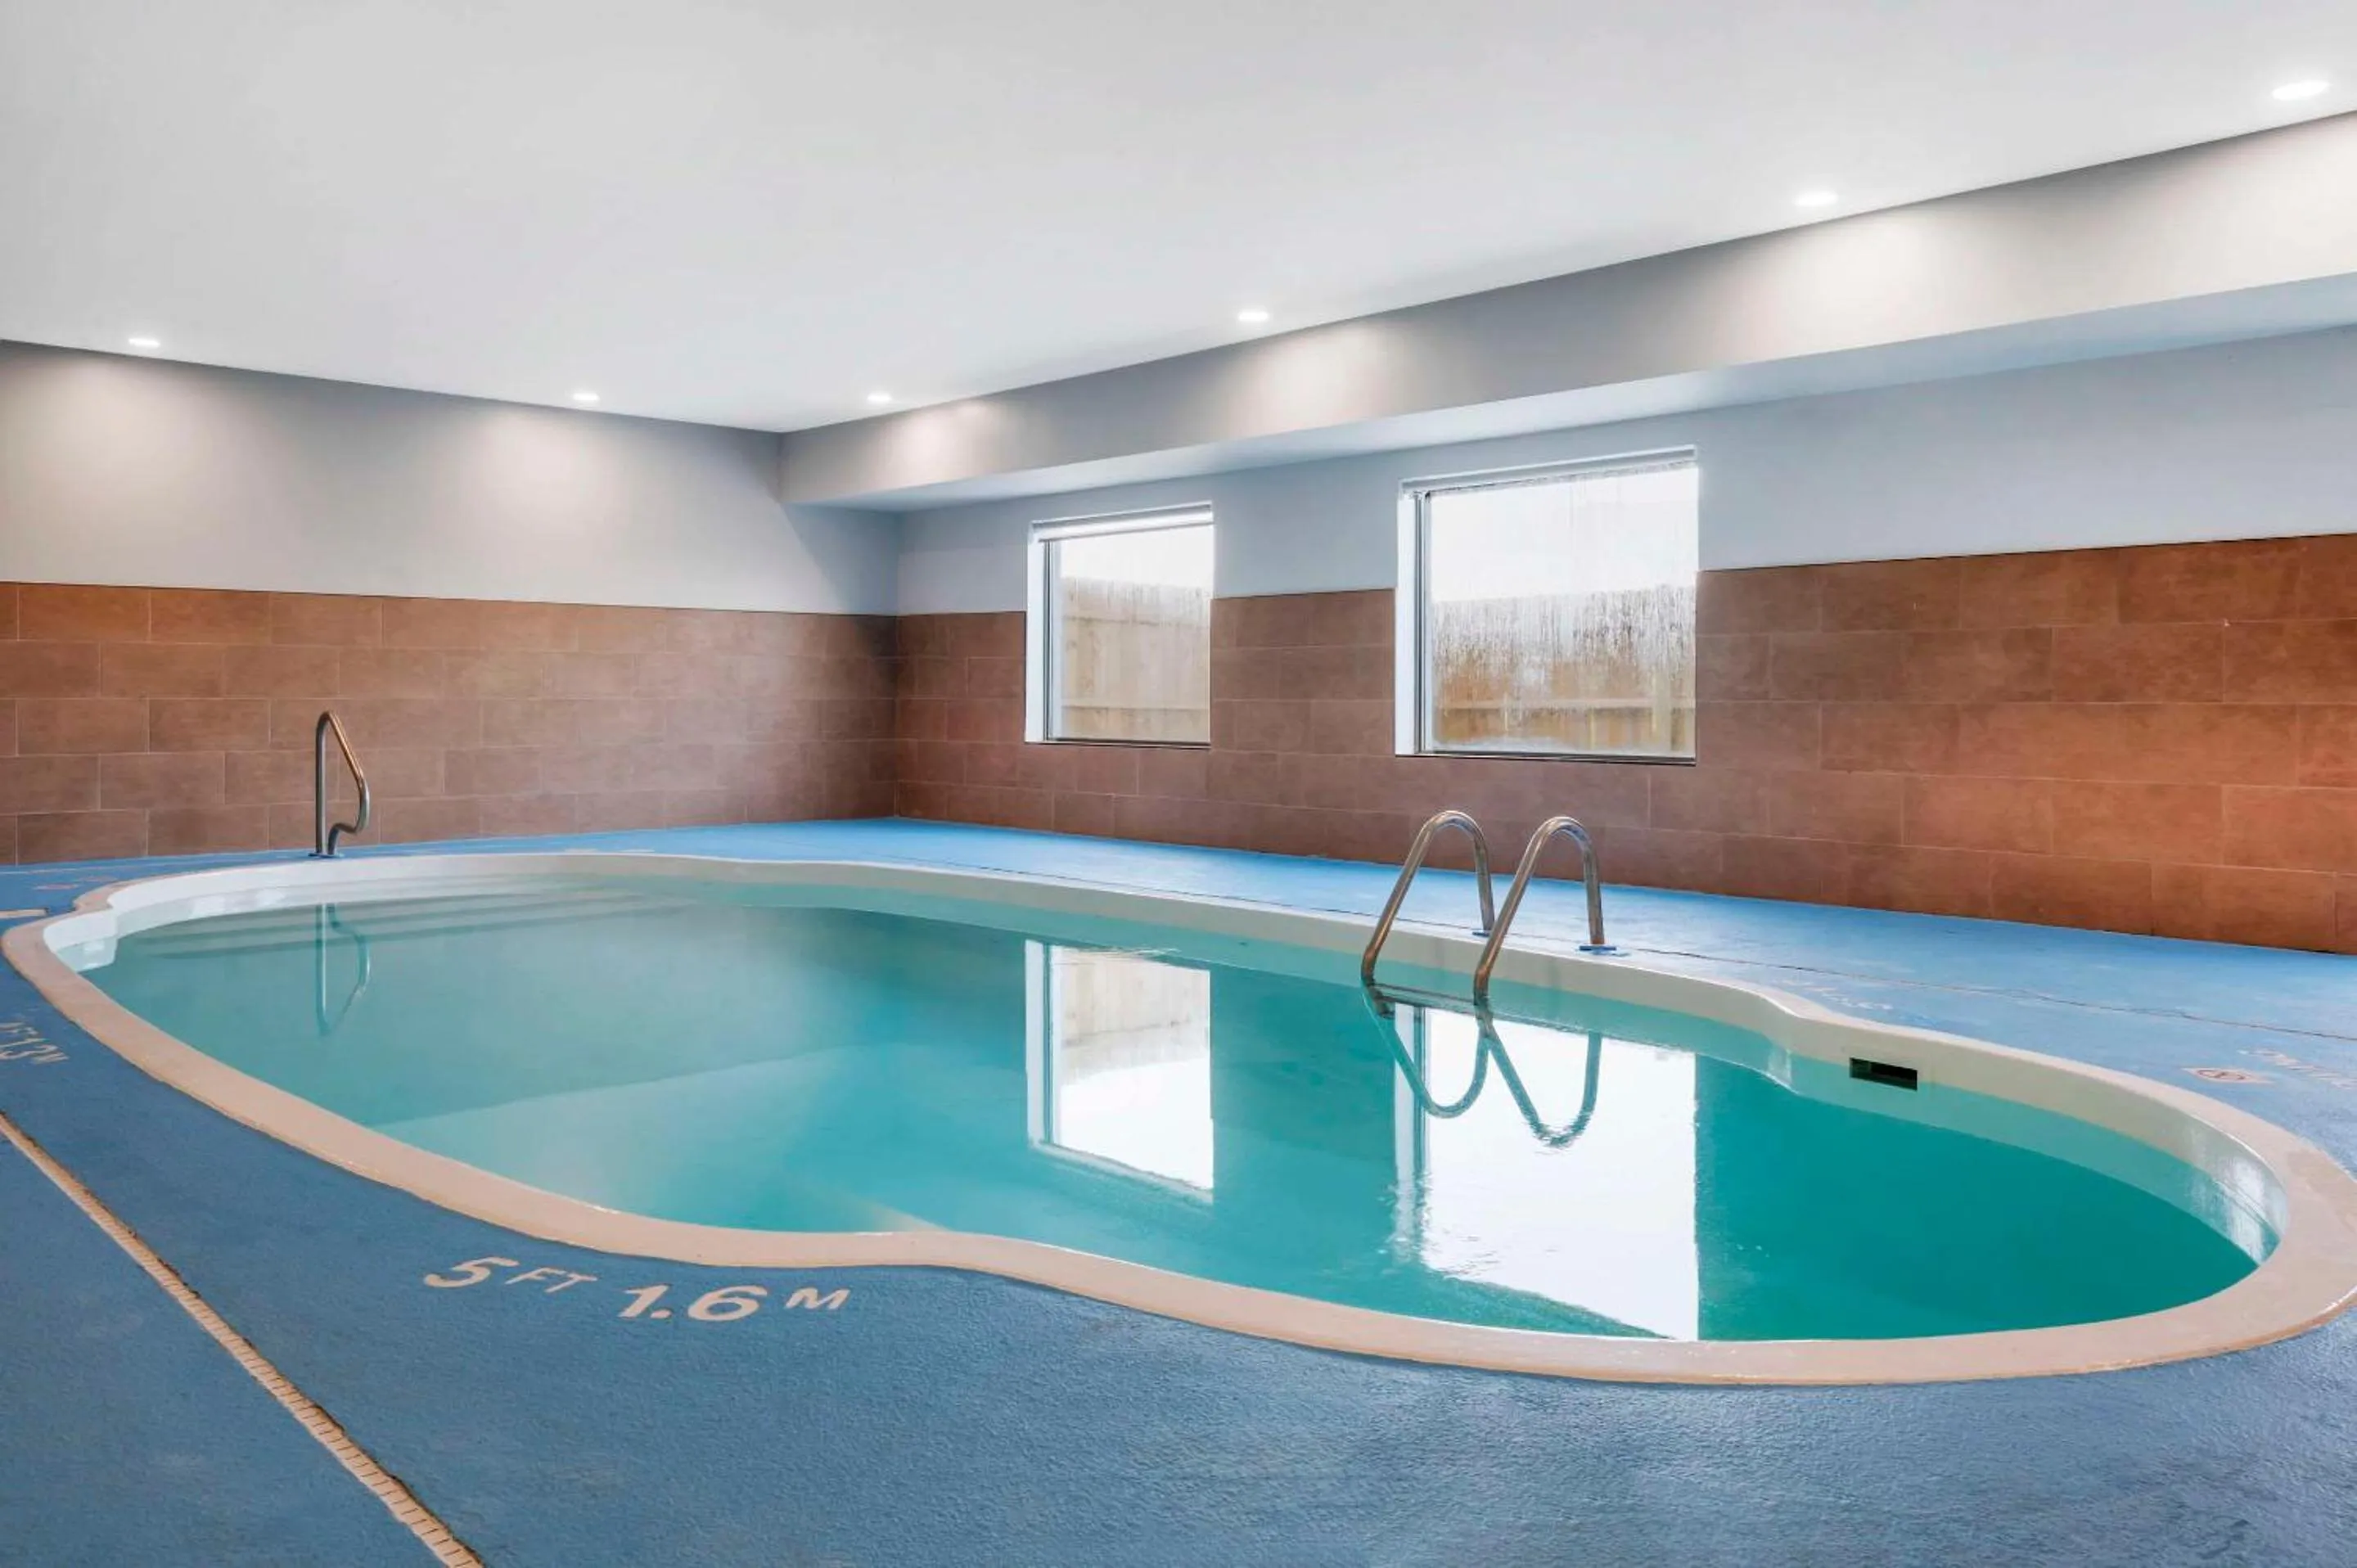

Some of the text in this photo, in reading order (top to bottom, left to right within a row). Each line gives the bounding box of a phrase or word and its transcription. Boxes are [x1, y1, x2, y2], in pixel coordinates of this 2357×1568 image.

[423, 1256, 851, 1322] 5 FT 1.6 M
